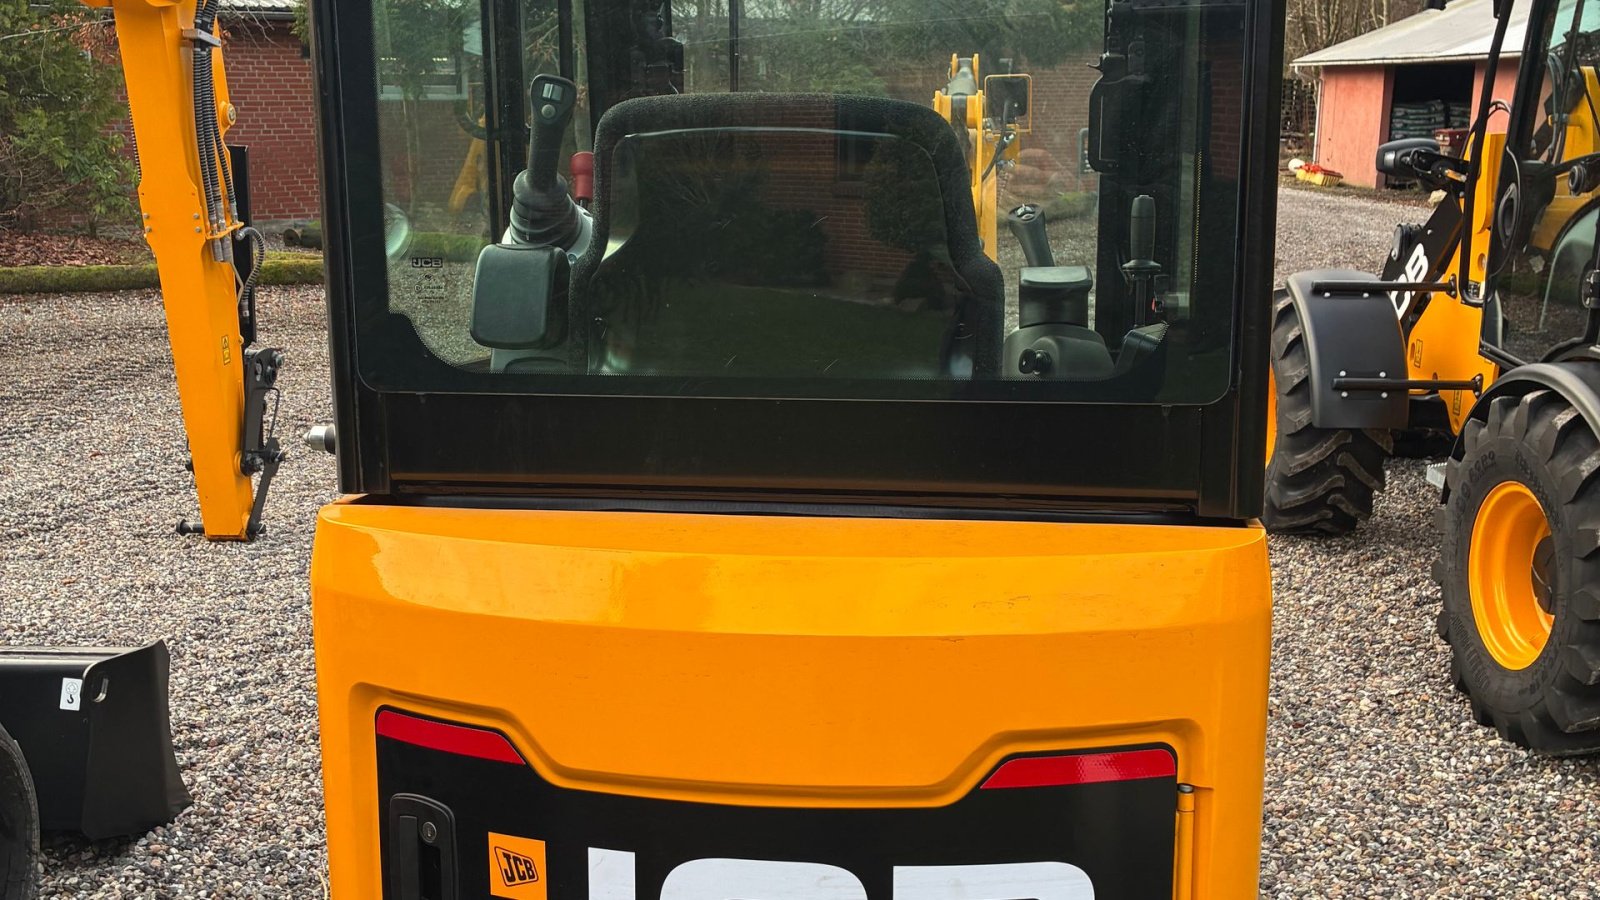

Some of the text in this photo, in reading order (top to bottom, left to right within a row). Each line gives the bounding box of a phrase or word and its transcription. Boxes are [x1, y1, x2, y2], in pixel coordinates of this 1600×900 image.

[412, 258, 442, 267] JCB
[1390, 242, 1429, 321] CB
[502, 851, 536, 883] JCB
